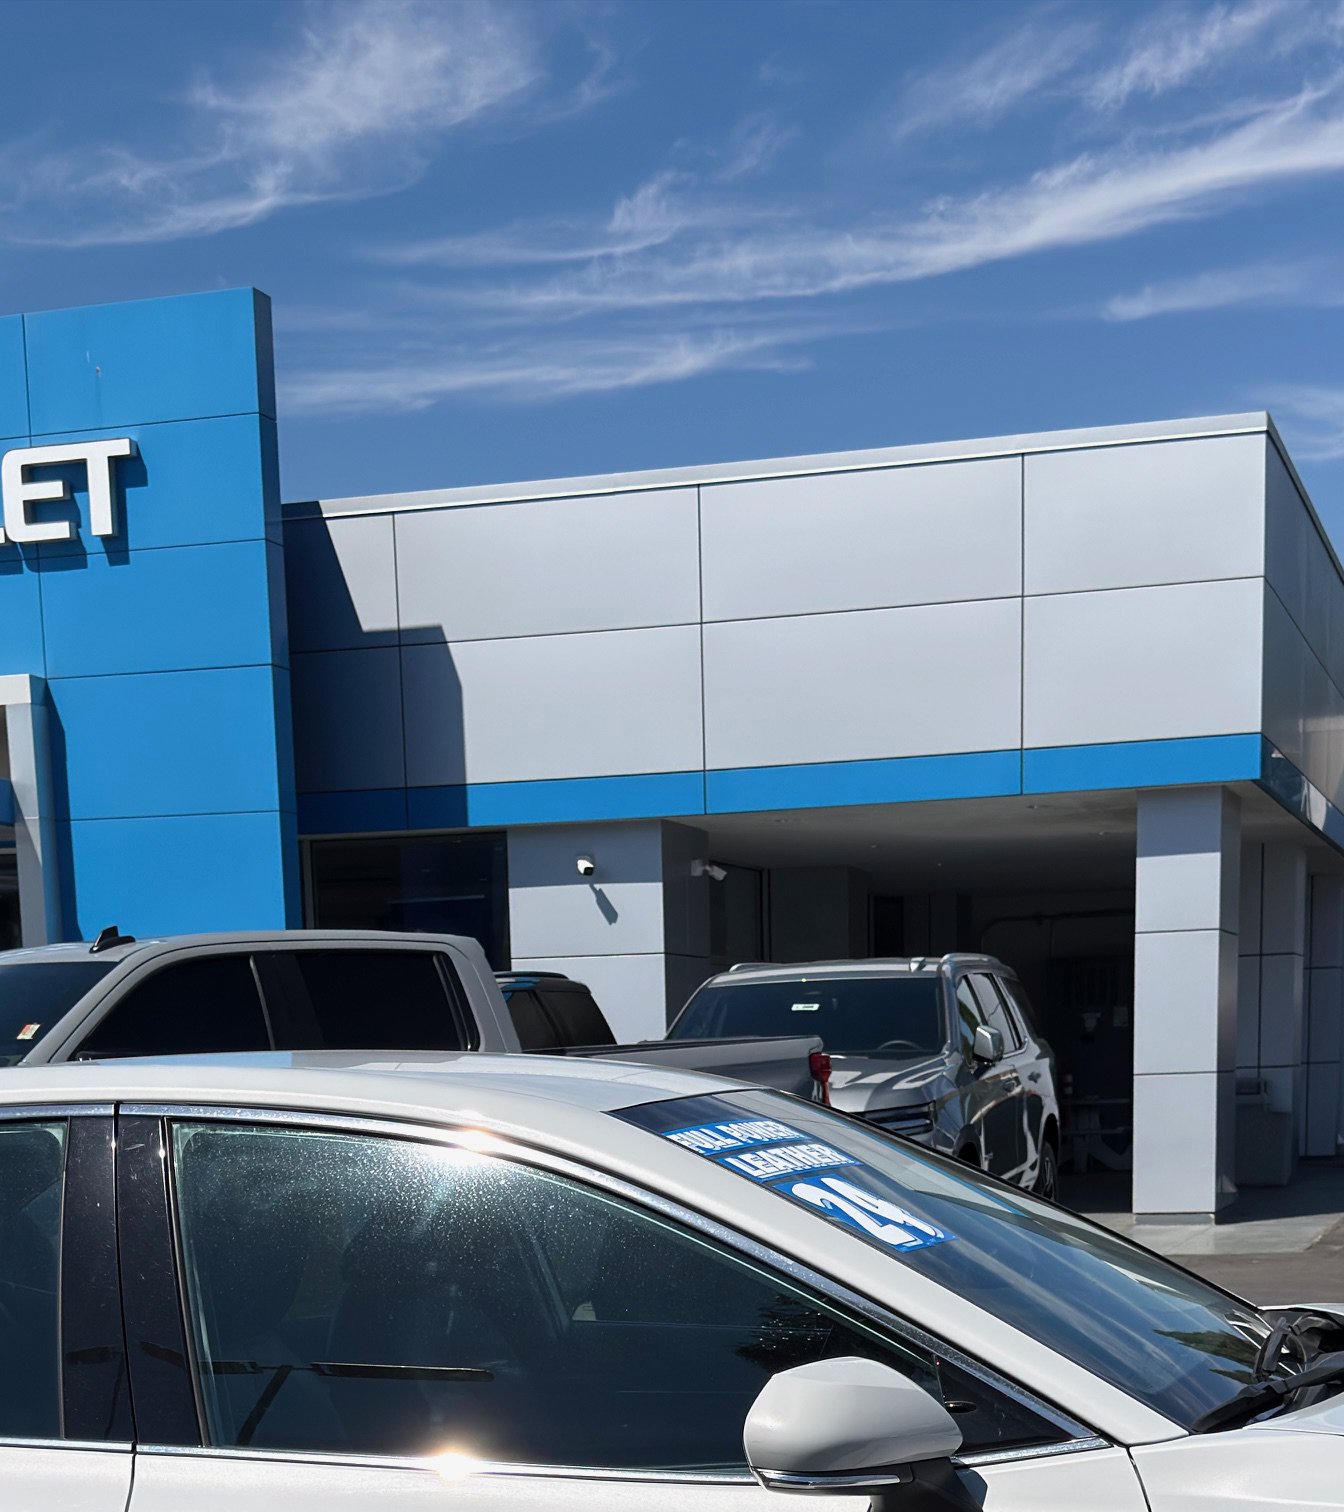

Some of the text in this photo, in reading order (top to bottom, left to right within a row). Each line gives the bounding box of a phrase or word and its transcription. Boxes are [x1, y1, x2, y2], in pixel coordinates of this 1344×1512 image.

[666, 1120, 806, 1153] FULL POWER
[724, 1143, 855, 1178] LEATHER
[792, 1177, 944, 1248] 24
